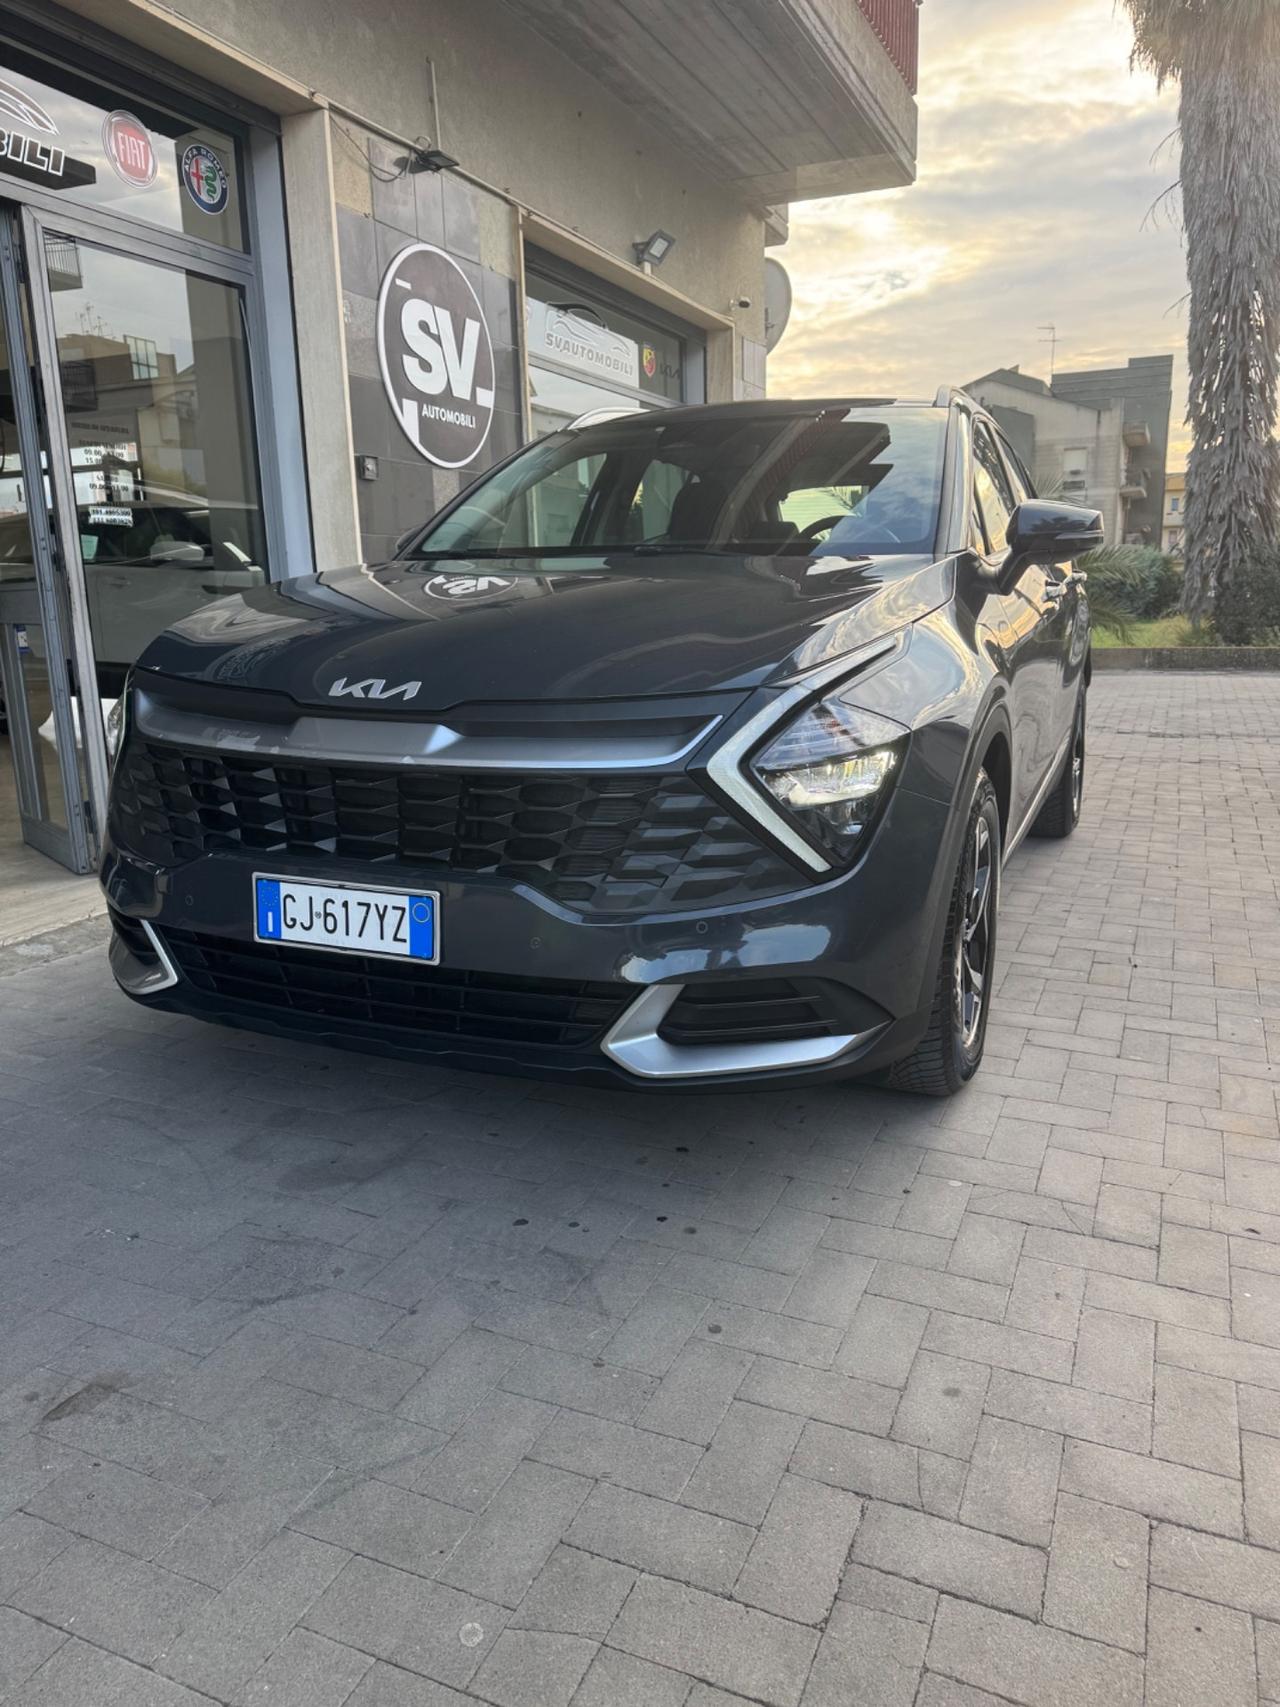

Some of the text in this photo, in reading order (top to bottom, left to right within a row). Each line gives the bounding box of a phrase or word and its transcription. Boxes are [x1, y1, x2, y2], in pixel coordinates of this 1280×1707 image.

[117, 132, 146, 170] FIAT
[184, 148, 227, 189] ALFA ROMEO
[401, 298, 481, 401] SV
[422, 403, 476, 429] AUTOMOBILI
[328, 677, 422, 700] KIA
